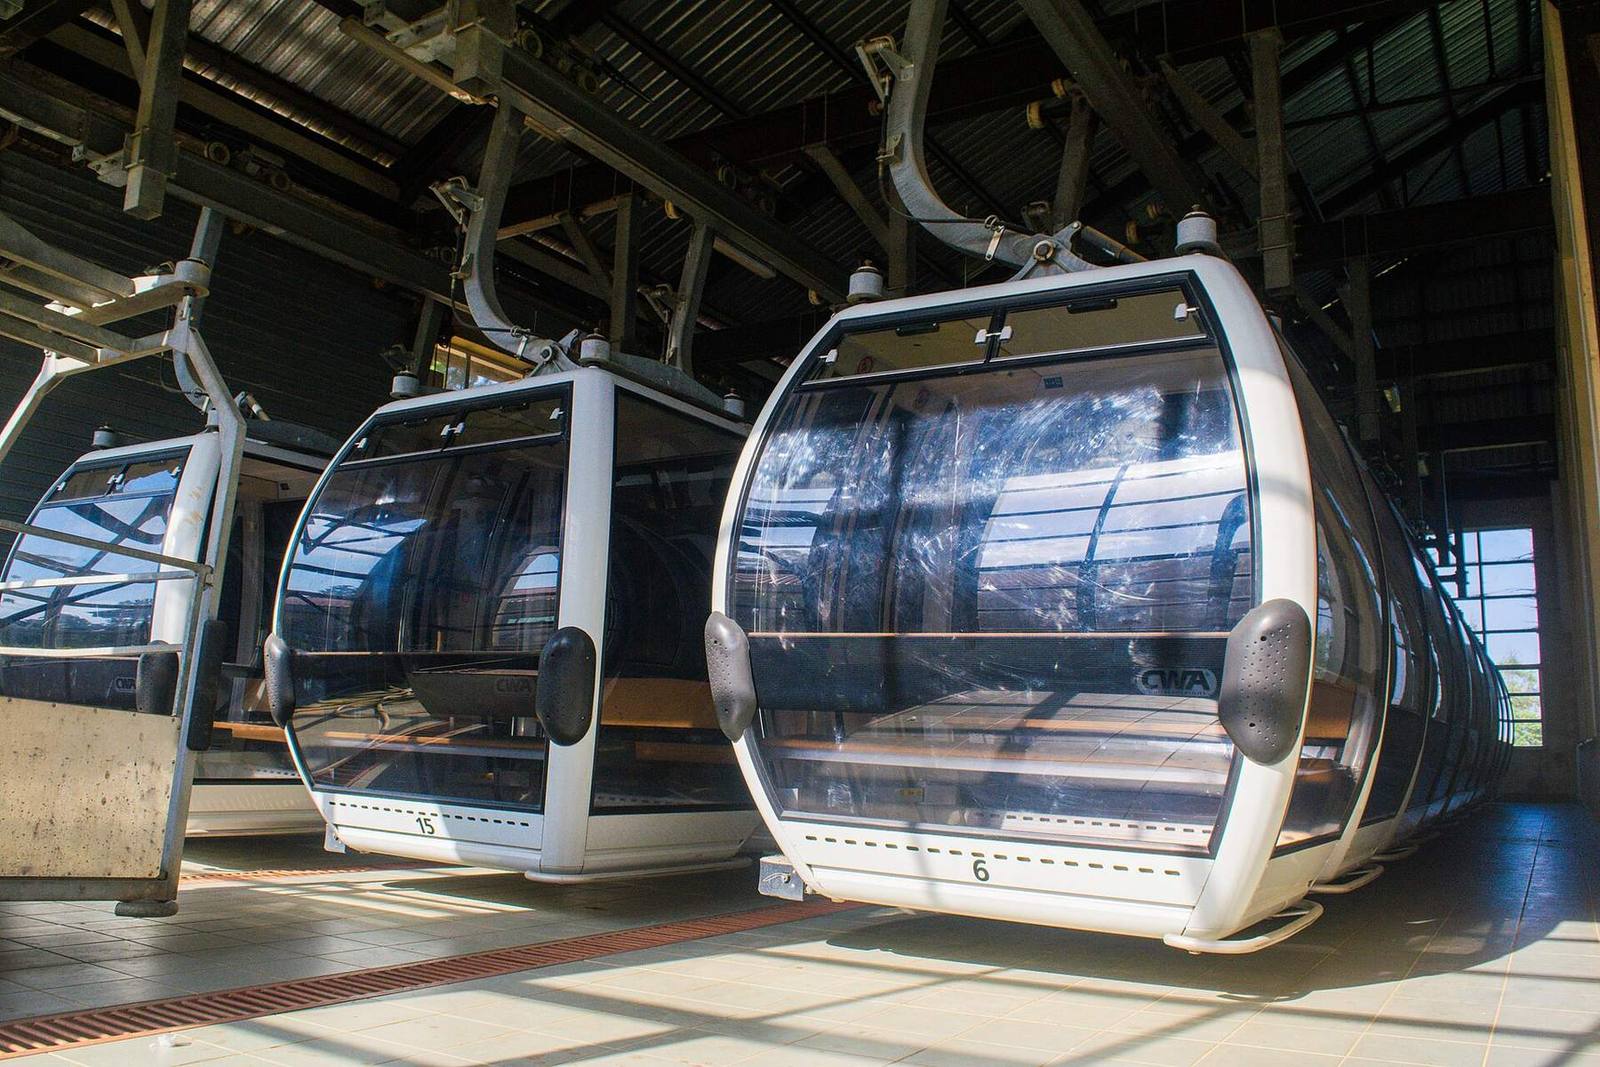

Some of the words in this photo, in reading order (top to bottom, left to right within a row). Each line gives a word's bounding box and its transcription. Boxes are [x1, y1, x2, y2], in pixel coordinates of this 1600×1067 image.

[1141, 670, 1211, 690] CWA
[416, 817, 435, 834] 15
[973, 860, 990, 881] 6
